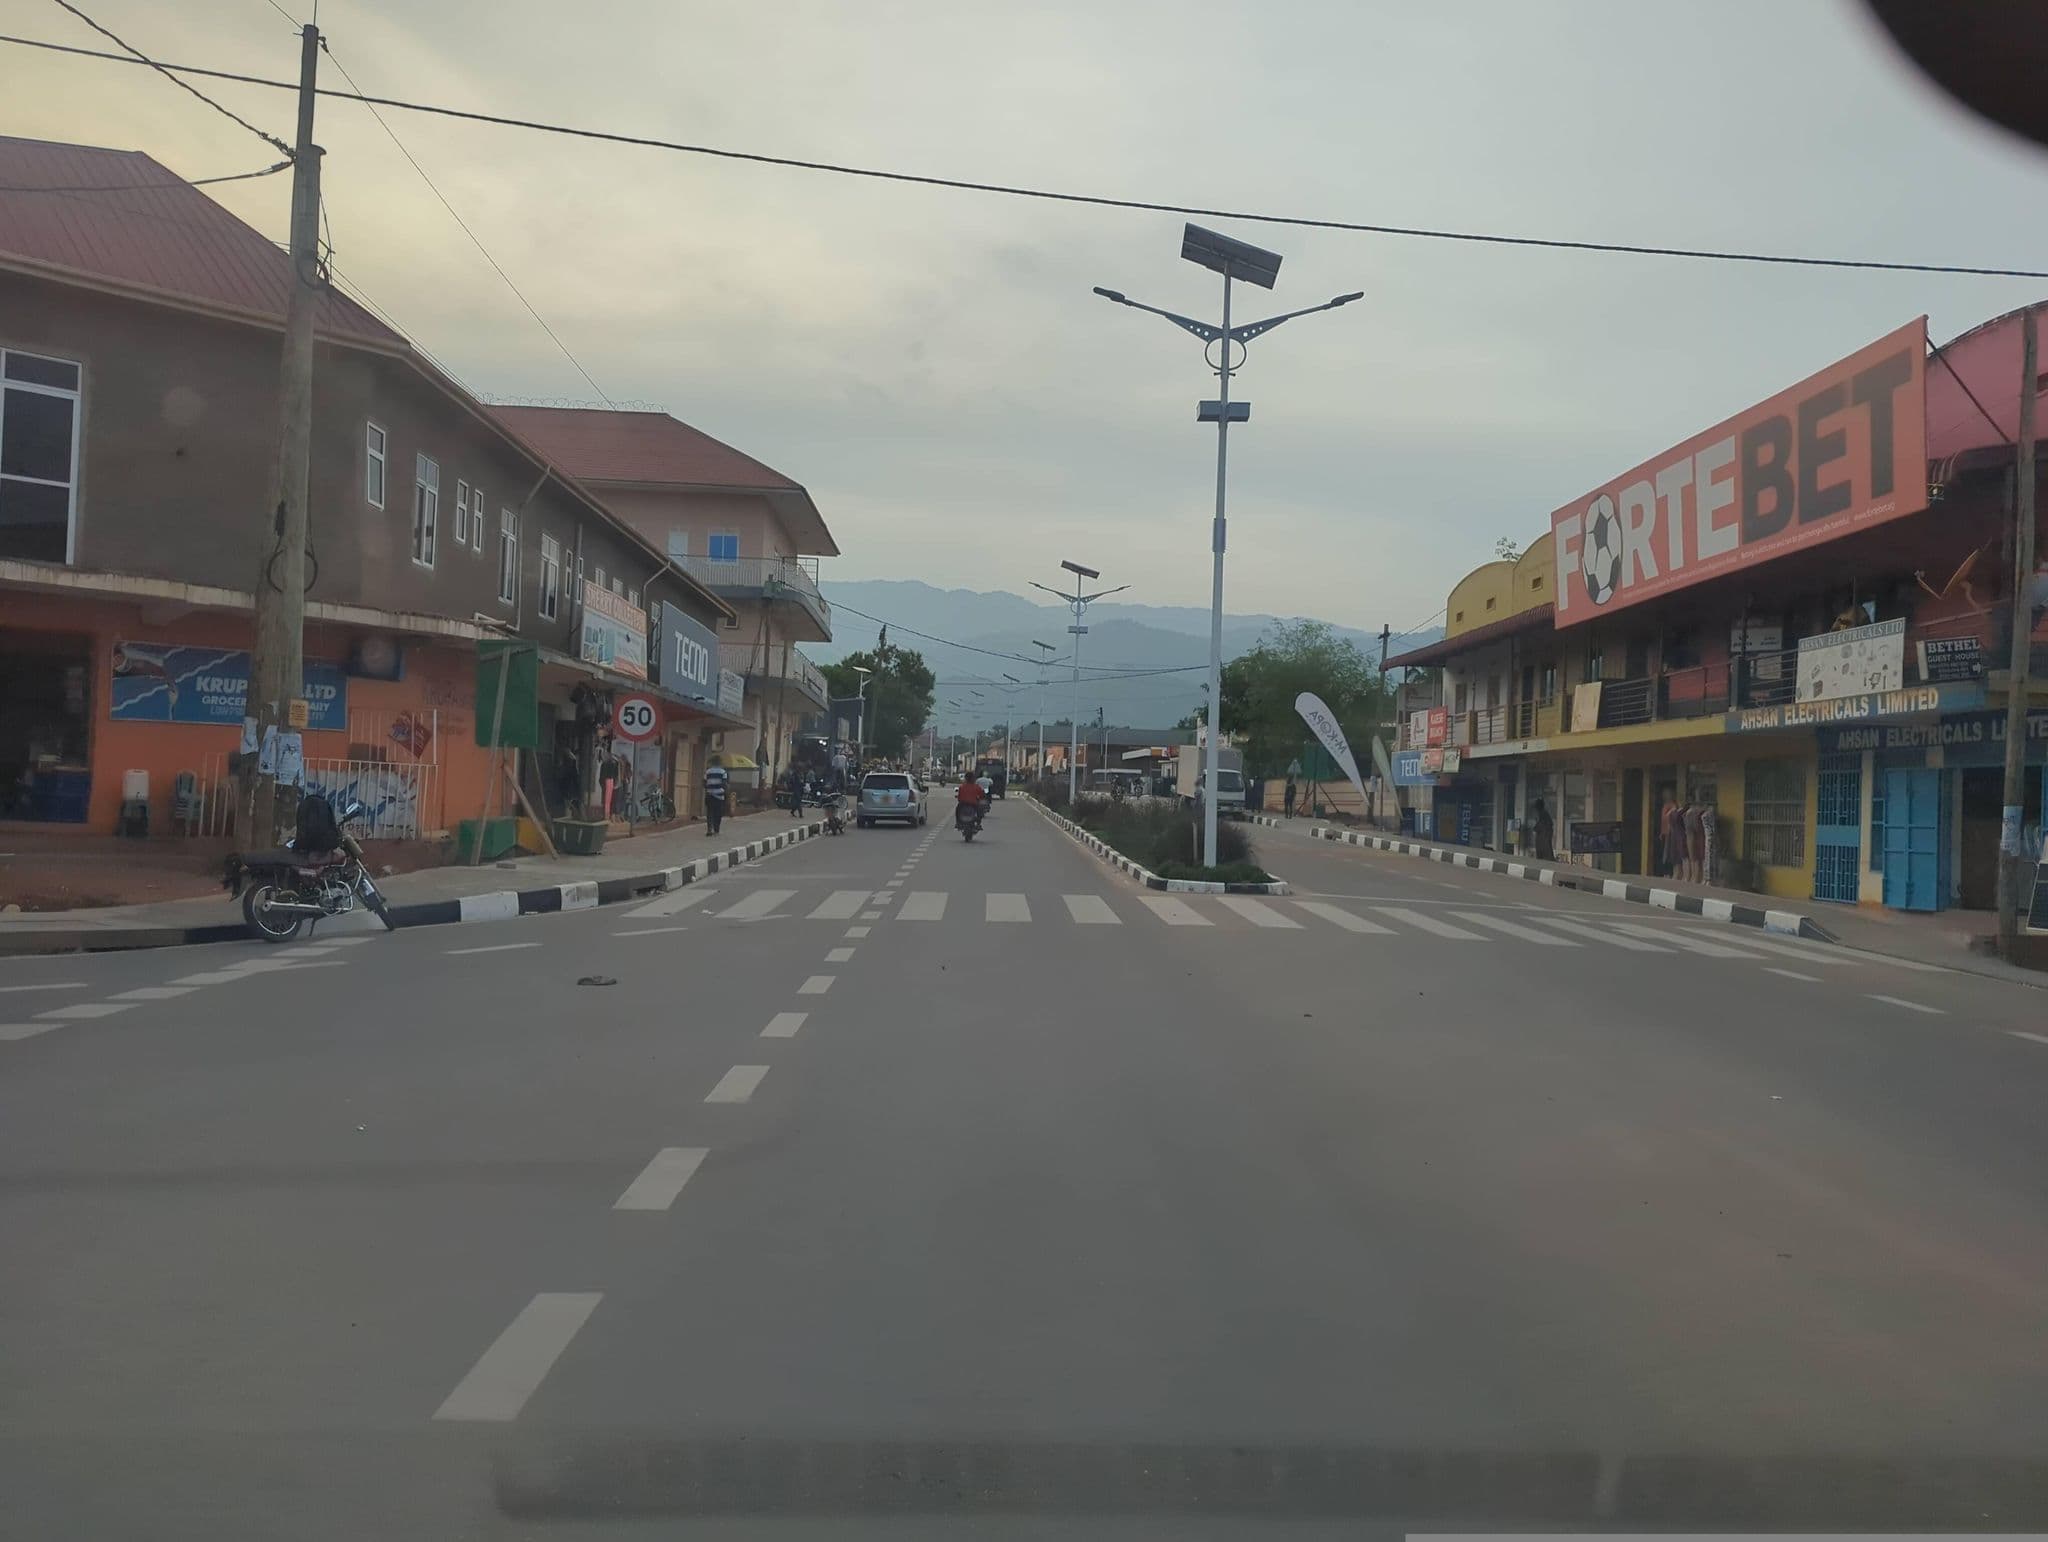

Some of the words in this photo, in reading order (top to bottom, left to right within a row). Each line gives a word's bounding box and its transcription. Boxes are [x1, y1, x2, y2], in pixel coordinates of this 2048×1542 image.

[1555, 347, 1912, 612] FORTEBET
[1801, 638, 1826, 652] AHSAN
[1828, 624, 1884, 646] ELECTRICALS
[1885, 620, 1903, 637] LTD
[1927, 639, 1980, 654] BETHEL
[675, 631, 708, 685] TECNO
[196, 676, 248, 693] KRUP
[202, 695, 247, 706] GROCER
[1741, 708, 1778, 730] AHSAN
[1785, 696, 1869, 725] ELECTRICALS
[1877, 687, 1939, 715] LIMITED
[624, 706, 651, 726] 50
[1838, 729, 1879, 750] AHSAN
[1886, 720, 1983, 747] ELECTRICALS
